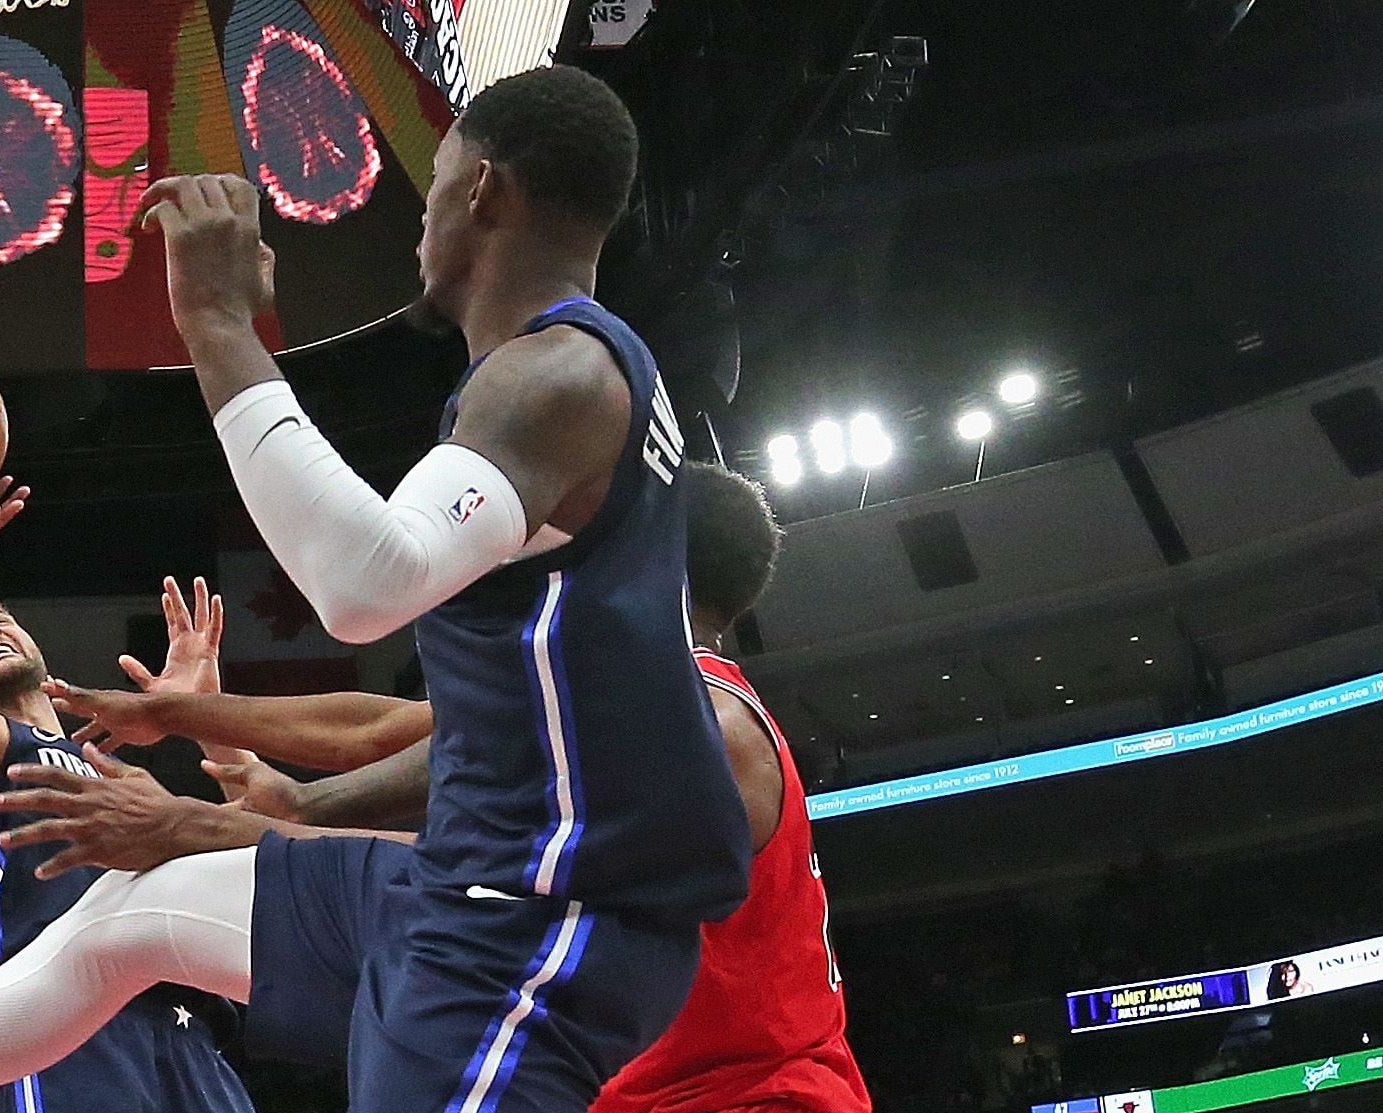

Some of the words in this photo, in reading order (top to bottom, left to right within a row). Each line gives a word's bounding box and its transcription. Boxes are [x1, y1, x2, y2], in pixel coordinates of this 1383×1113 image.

[1177, 726, 1217, 744] Family
[1219, 716, 1258, 736] owned
[1259, 704, 1306, 724] furniture
[1308, 694, 1338, 711] store
[1340, 686, 1368, 702] since
[811, 796, 846, 812] Family
[993, 764, 1020, 778] 1912
[1111, 990, 1147, 1008] JANET
[1149, 982, 1203, 1003] JACKSON
